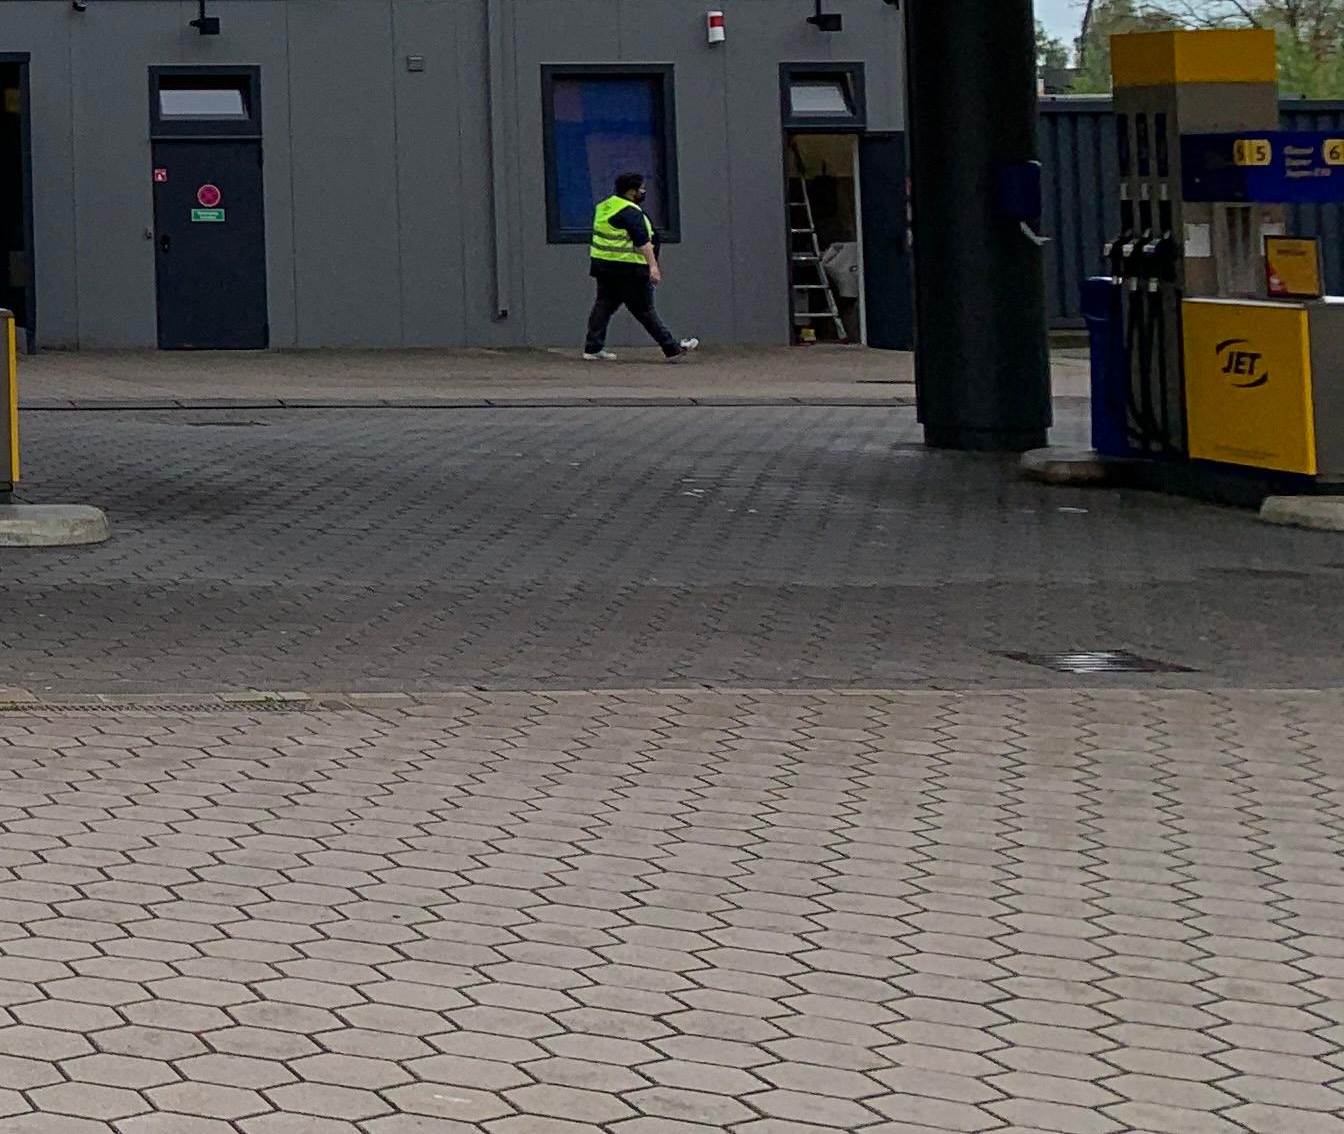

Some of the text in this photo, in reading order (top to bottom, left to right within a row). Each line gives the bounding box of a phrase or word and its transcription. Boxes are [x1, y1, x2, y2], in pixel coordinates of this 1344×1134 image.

[1256, 145, 1266, 162] 5
[1329, 145, 1340, 160] 6
[1221, 351, 1262, 375] JET
